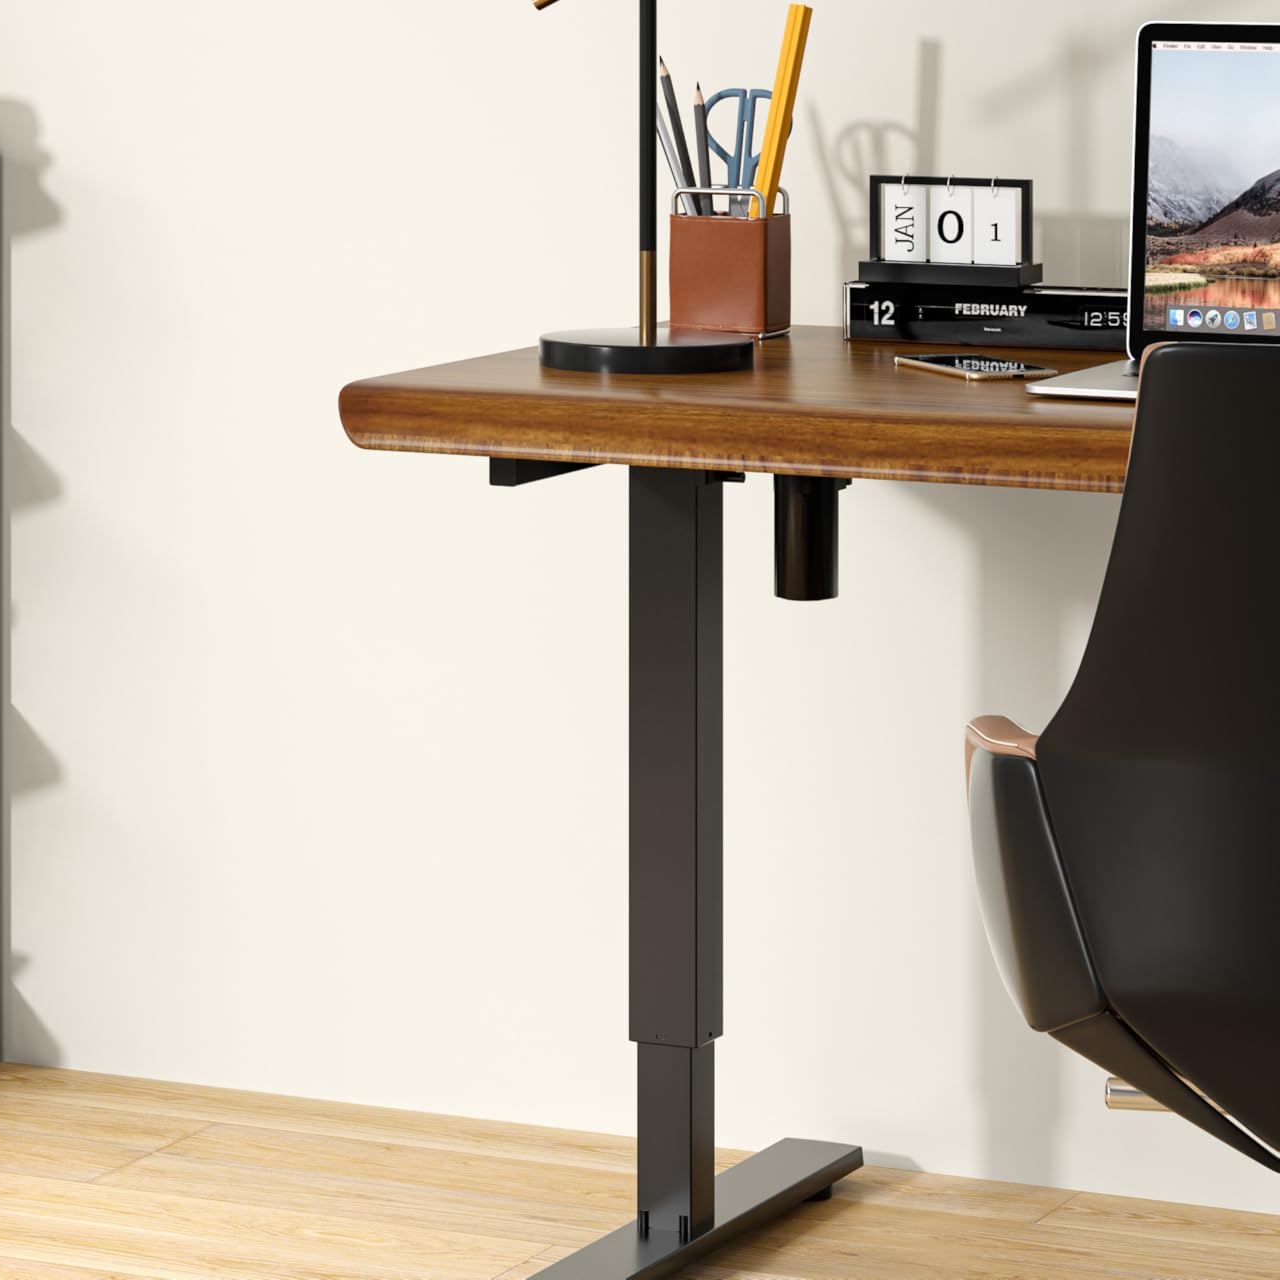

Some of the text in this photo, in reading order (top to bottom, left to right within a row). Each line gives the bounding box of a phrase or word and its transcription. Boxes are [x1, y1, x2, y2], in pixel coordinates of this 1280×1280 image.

[894, 204, 914, 253] JAN
[990, 223, 1001, 242] 1
[869, 301, 895, 325] 12
[954, 303, 1027, 318] FEBRUARY
